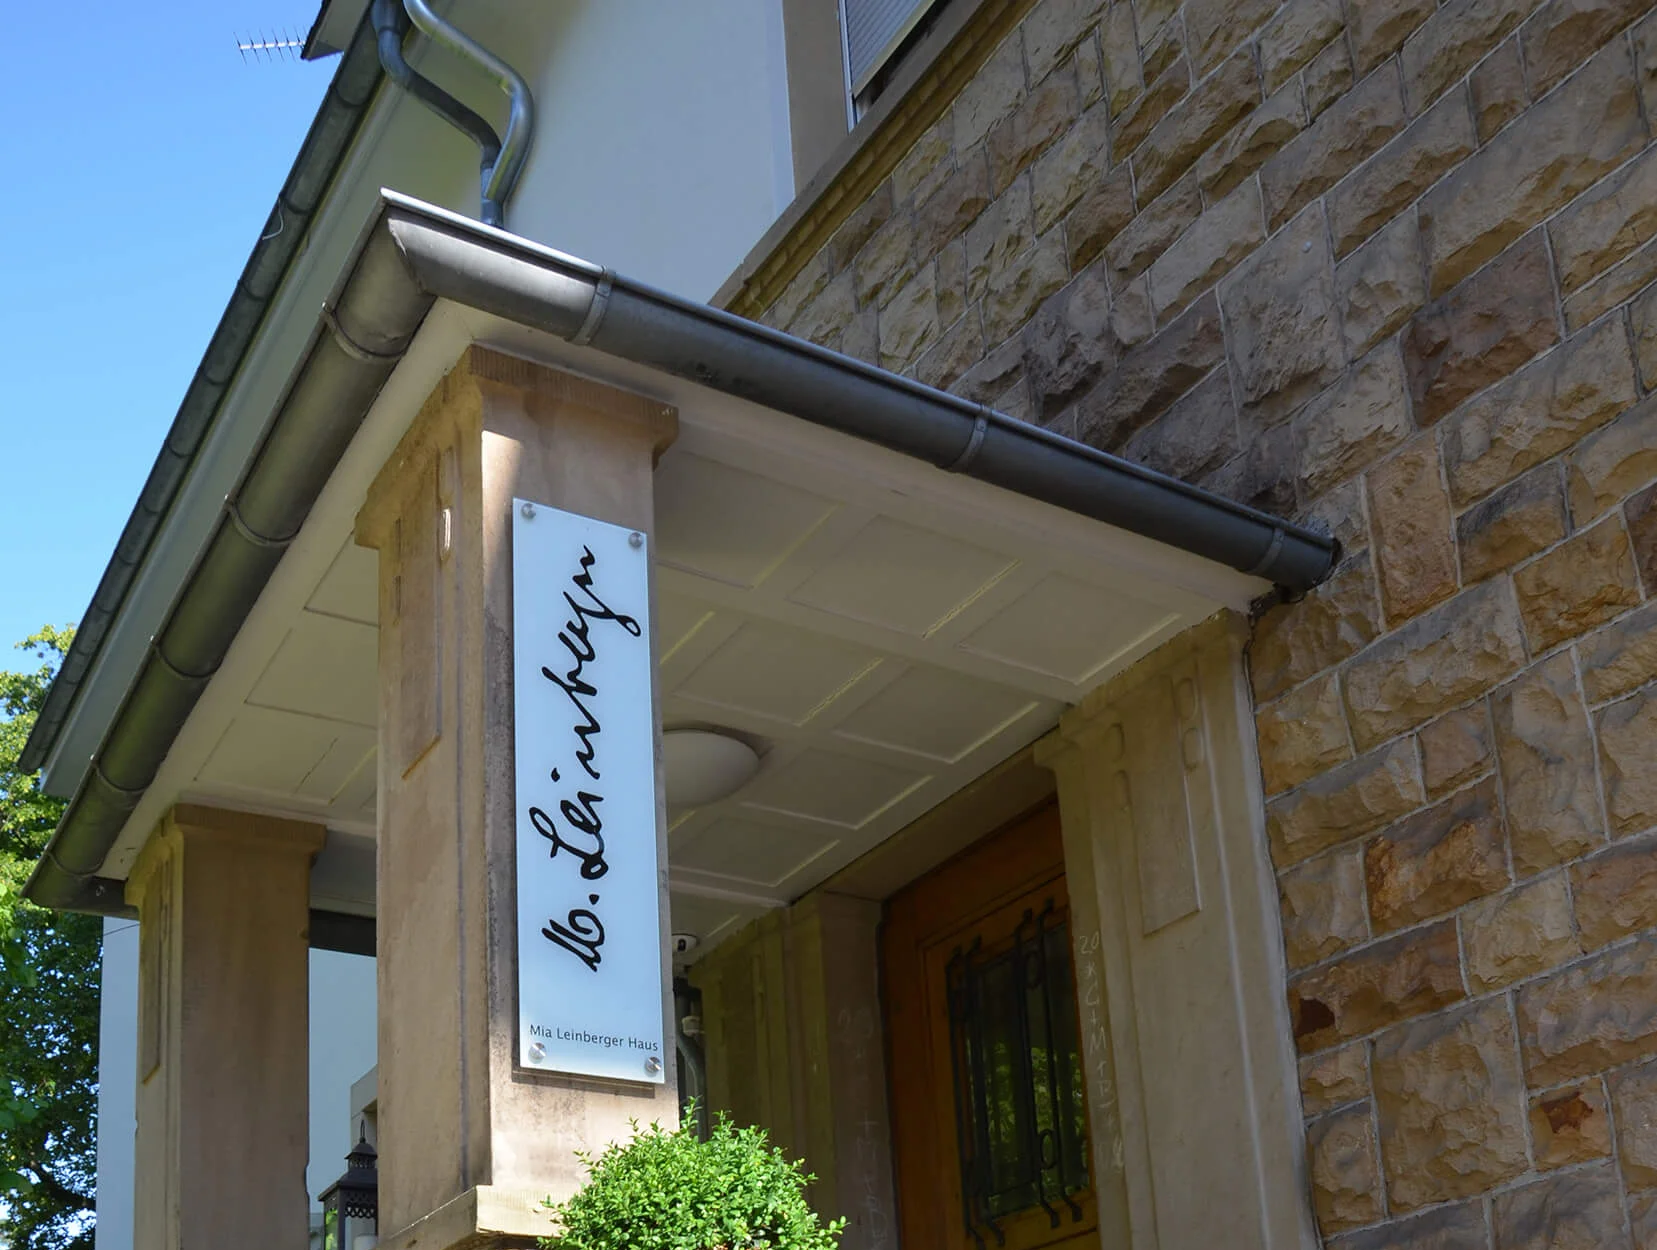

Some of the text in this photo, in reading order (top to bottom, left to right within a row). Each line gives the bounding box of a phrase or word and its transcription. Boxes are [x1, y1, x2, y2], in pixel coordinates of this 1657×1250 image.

[529, 1023, 659, 1052] Mia Leinberger Haus
